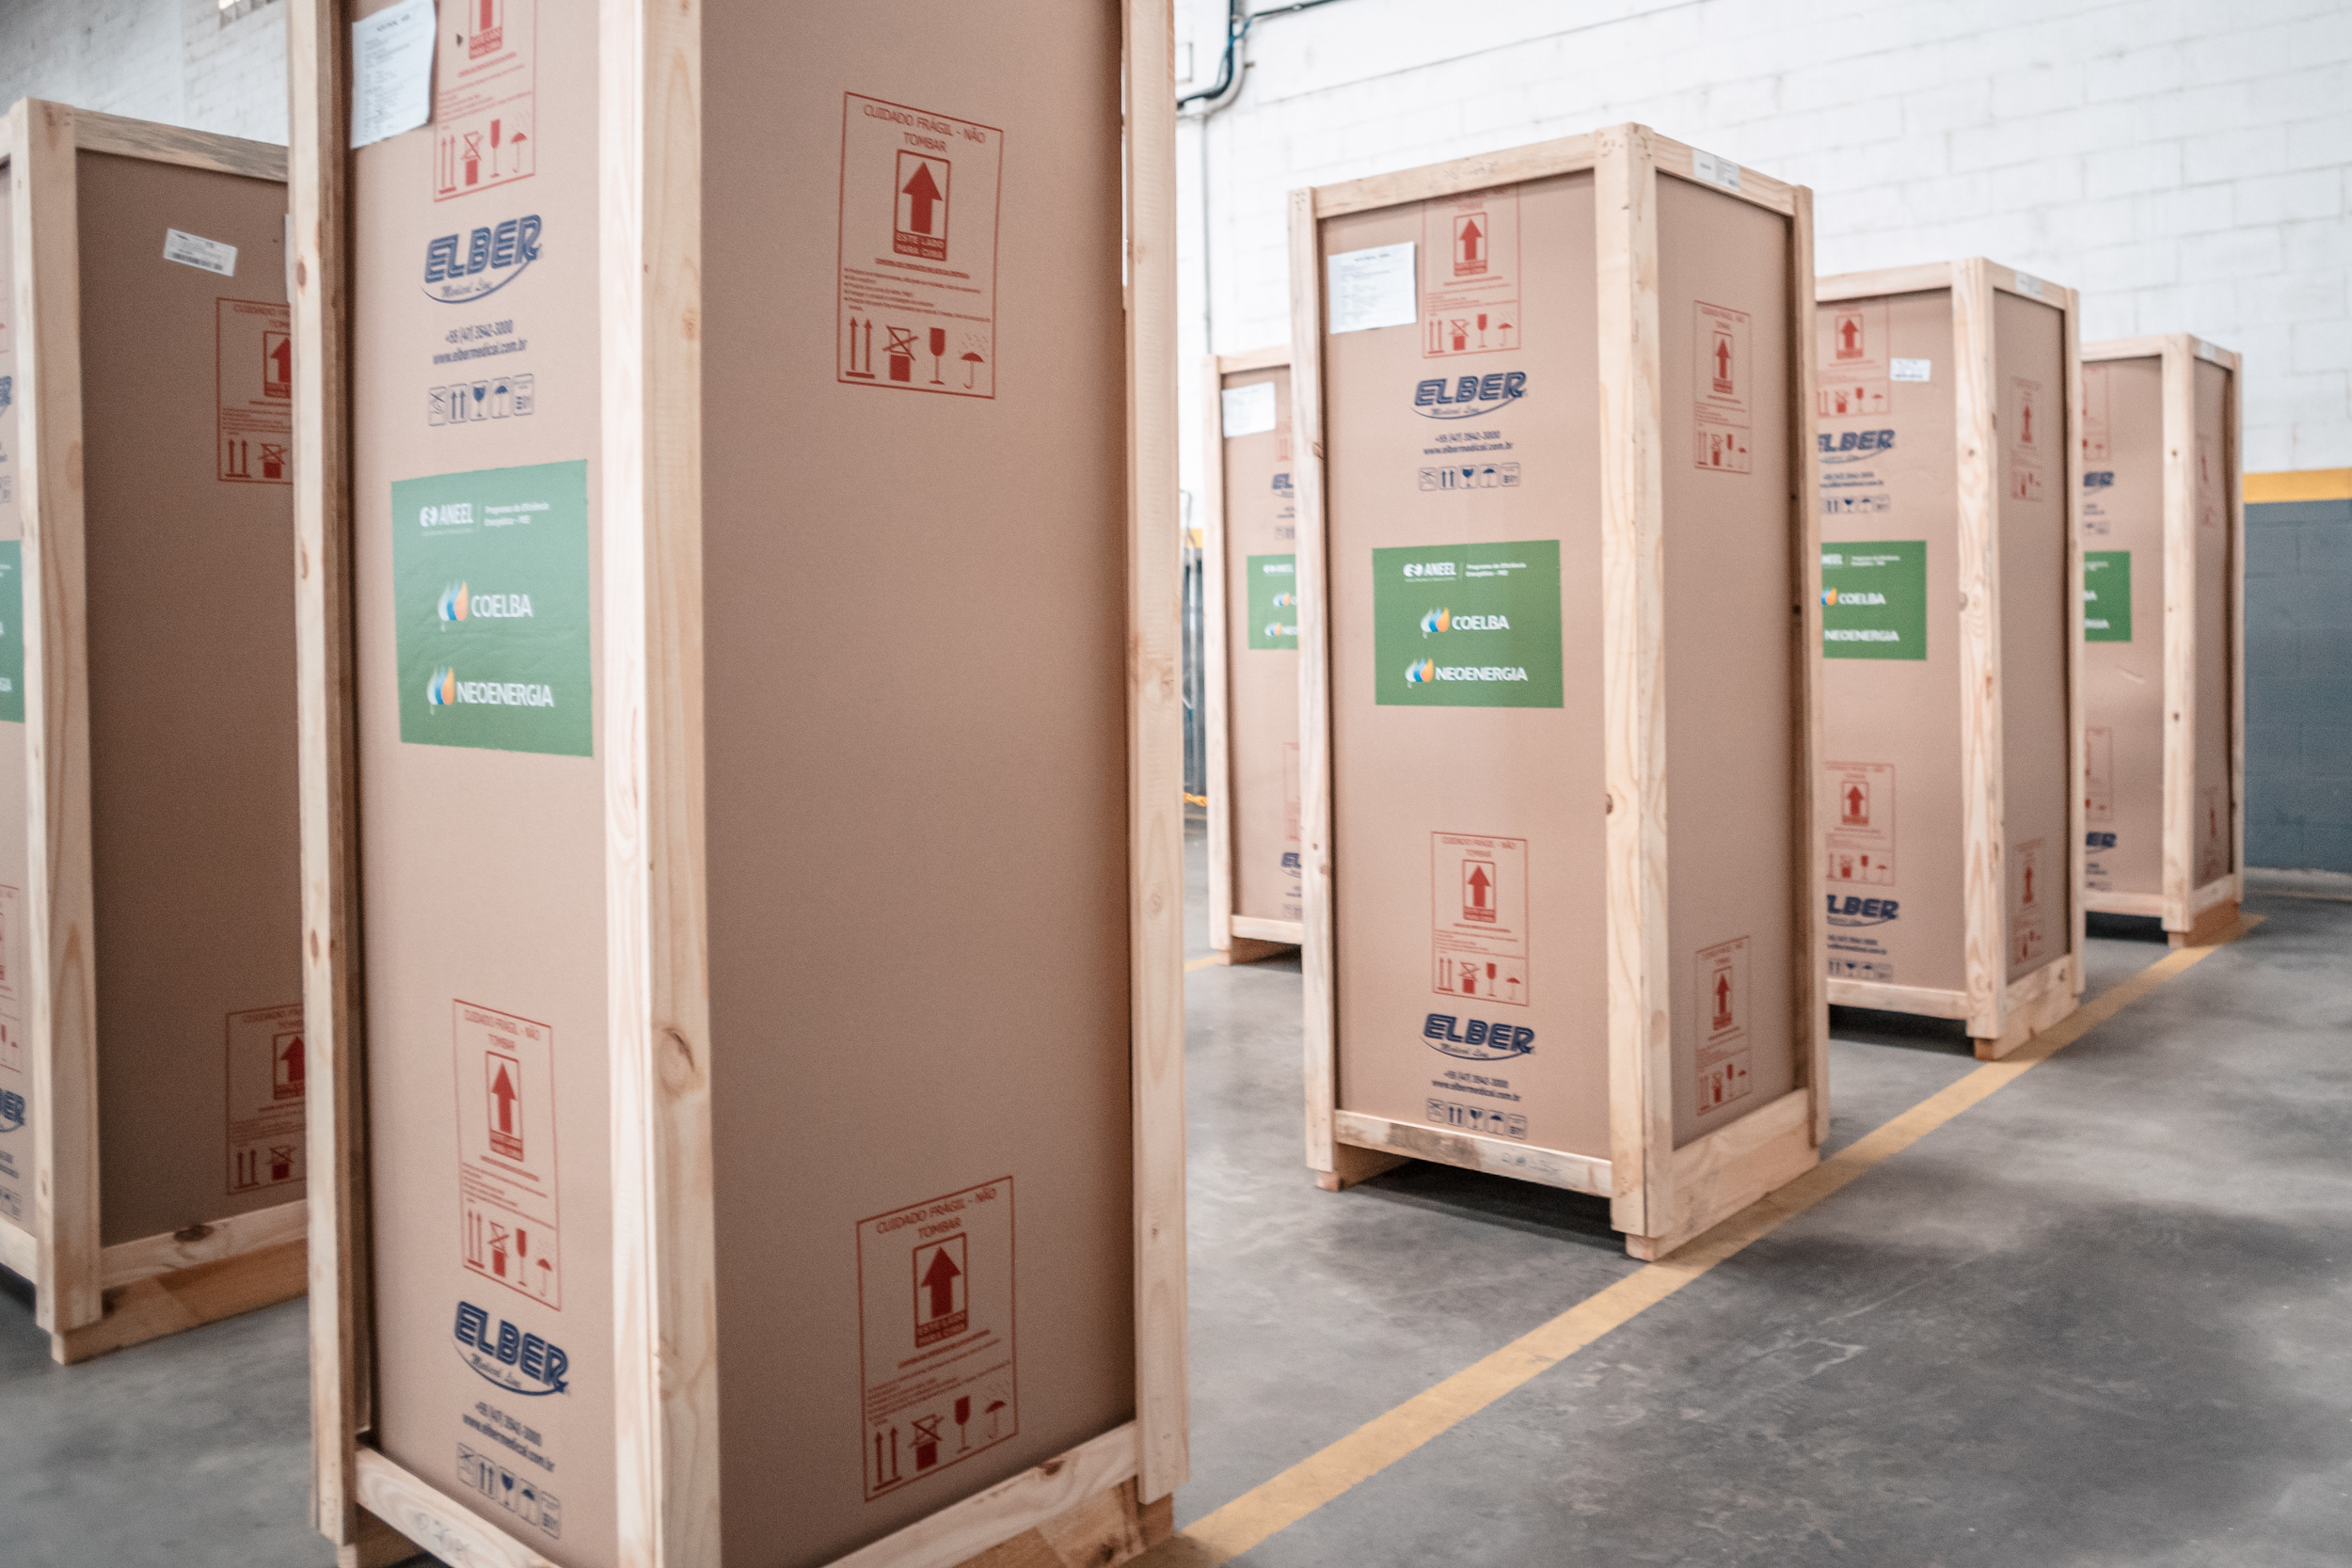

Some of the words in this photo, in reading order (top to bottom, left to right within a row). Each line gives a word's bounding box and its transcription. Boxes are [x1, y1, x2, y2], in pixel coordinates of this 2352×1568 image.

[864, 103, 914, 127] CUIDADO
[916, 117, 953, 137] FRÁGIL
[963, 127, 986, 143] NÃO
[903, 132, 947, 152] TOMBAR
[424, 214, 543, 284] ELBER
[1414, 371, 1526, 406] ELBER
[438, 502, 474, 526] ANEEL
[1422, 562, 1456, 577] ANEEL
[470, 594, 533, 619] COELBA
[1838, 592, 1886, 605] COELBA
[1452, 614, 1510, 630] COELBA
[1823, 628, 1900, 641] NEOENERGIA
[1435, 666, 1529, 682] NEOENERGIA
[456, 681, 554, 707] NEOENERGIA
[1826, 894, 1899, 921] LBER
[1423, 1013, 1534, 1053] ELBER
[454, 1301, 568, 1392] ELBER
